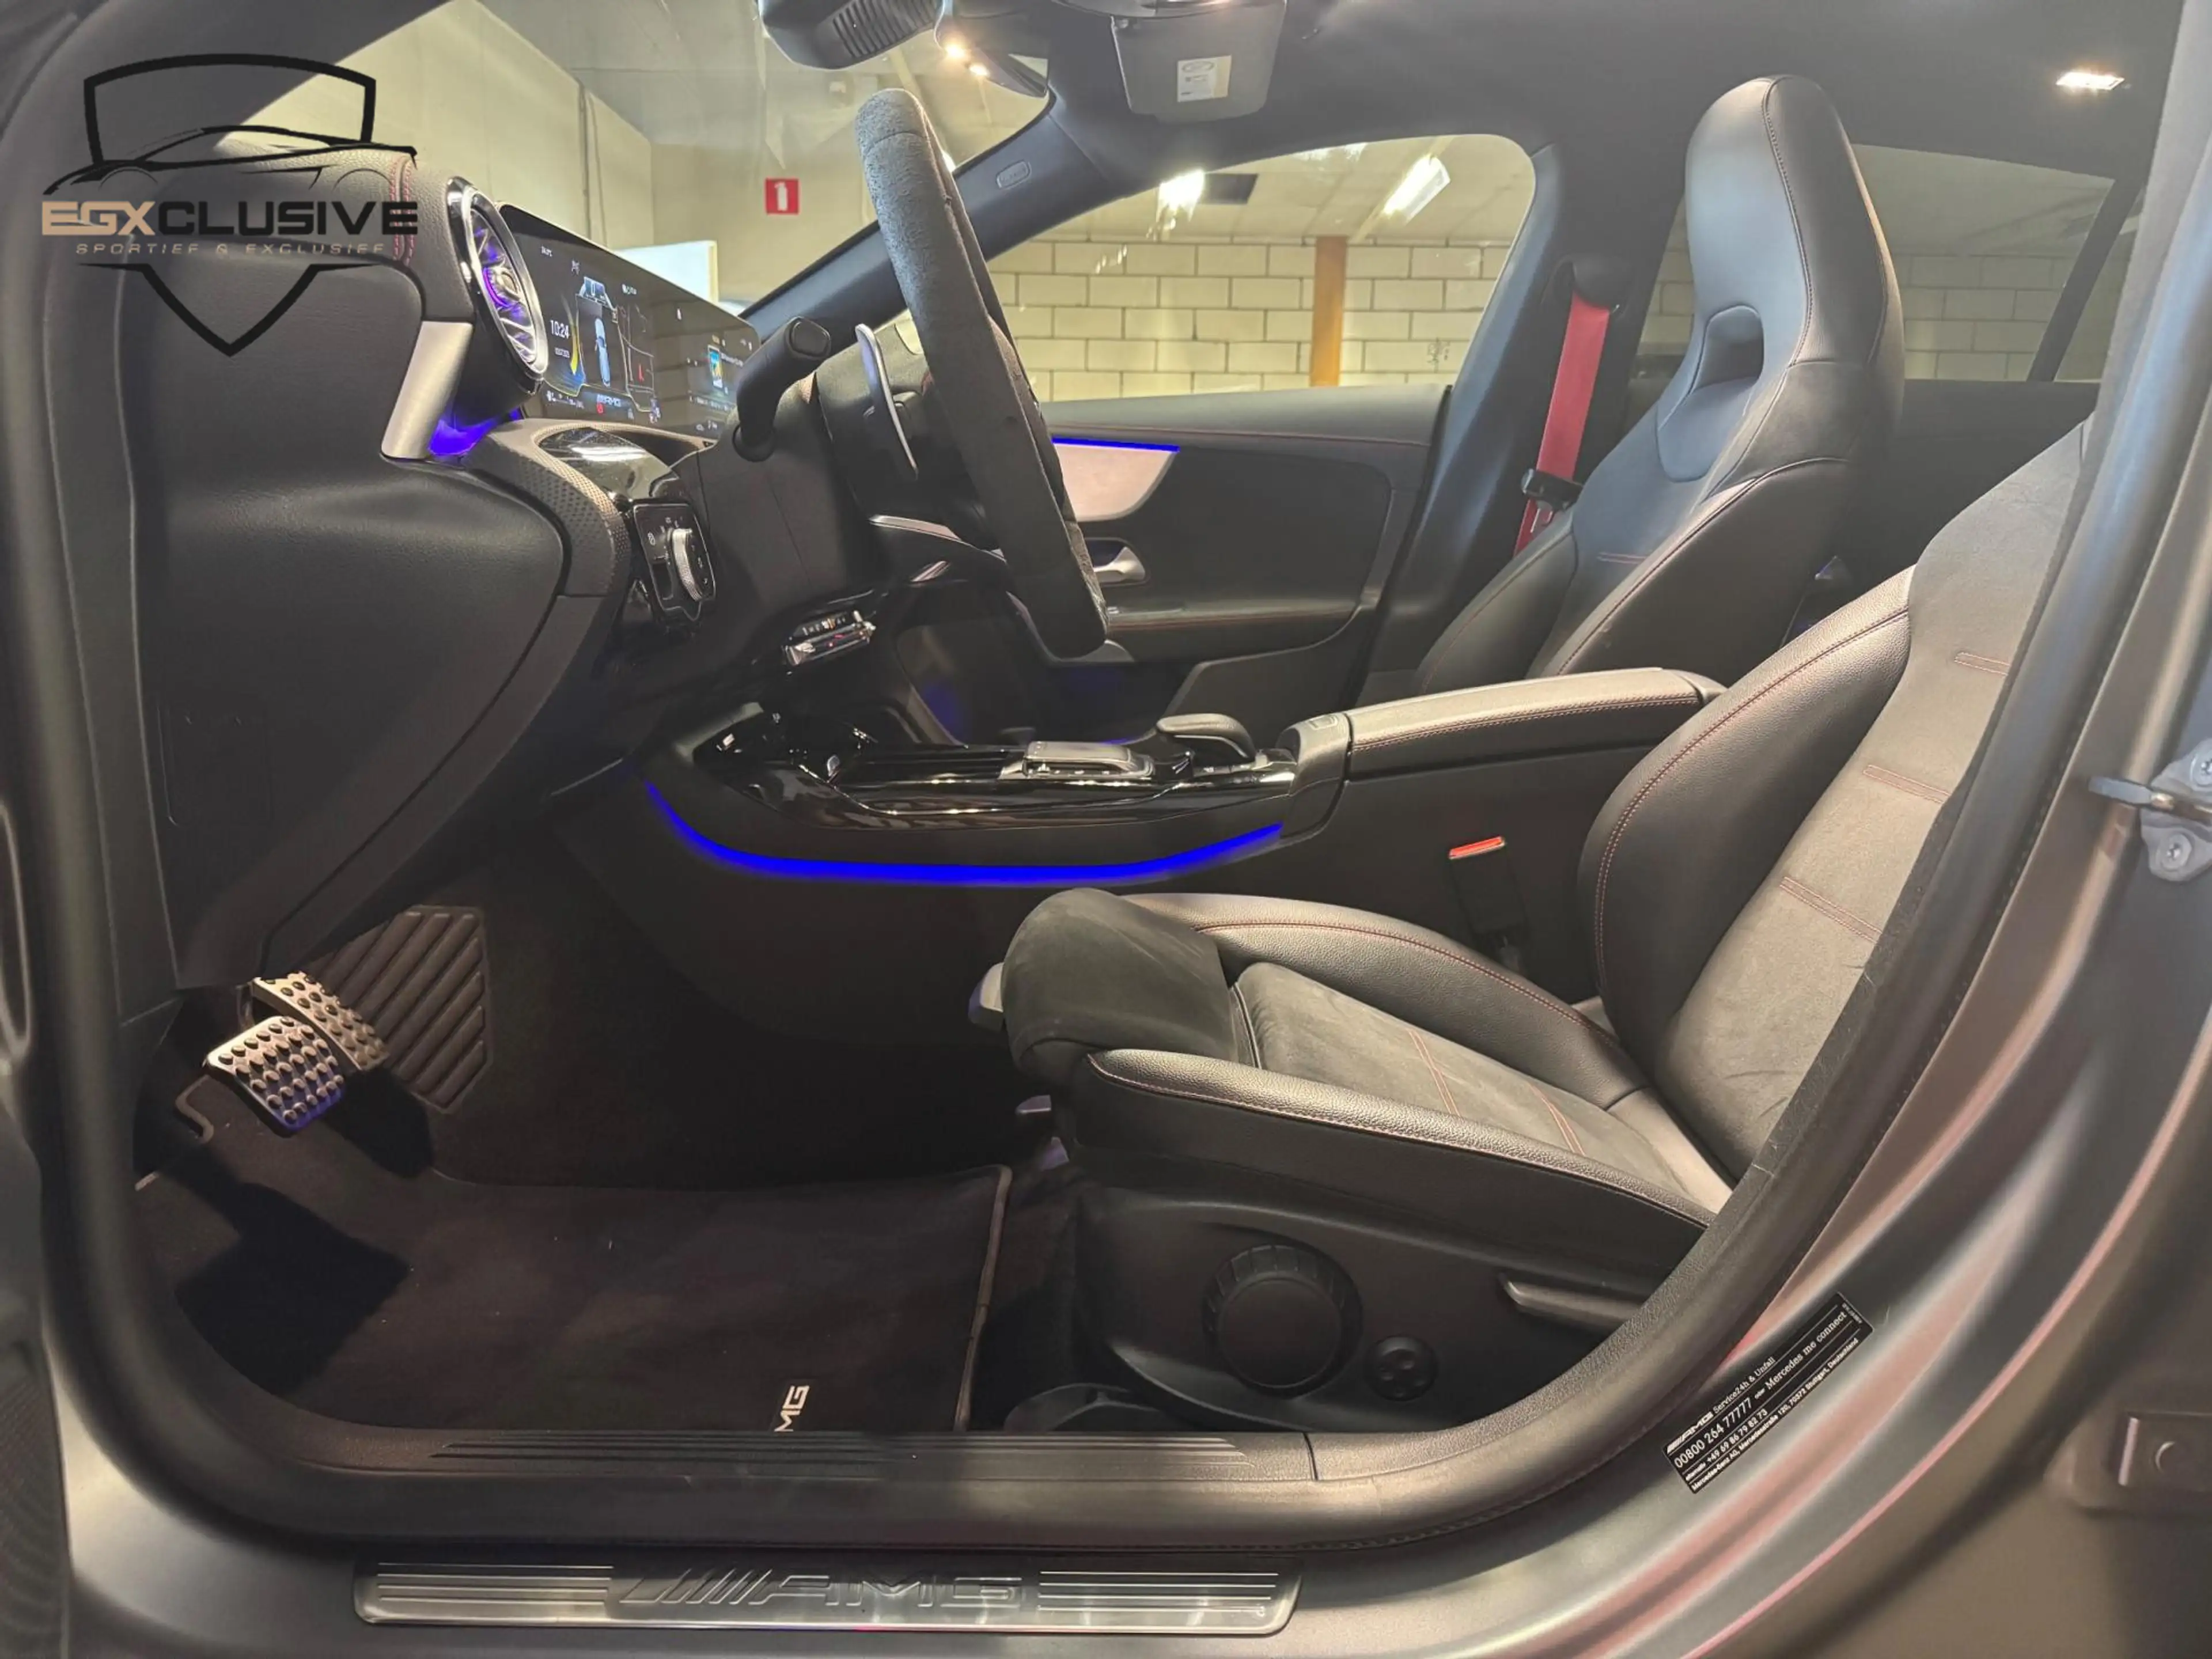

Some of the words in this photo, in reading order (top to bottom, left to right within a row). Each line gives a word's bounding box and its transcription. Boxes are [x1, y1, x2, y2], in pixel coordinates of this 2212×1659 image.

[774, 181, 788, 211] 1
[550, 320, 570, 339] 10:24
[1753, 1357, 1776, 1377] Unfall
[1674, 1439, 1706, 1468] 00800
[1704, 1423, 1725, 1444] 264
[1722, 1397, 1752, 1427] 77777
[1764, 1353, 1804, 1390] Mercedes
[1816, 1311, 1847, 1343] connect
